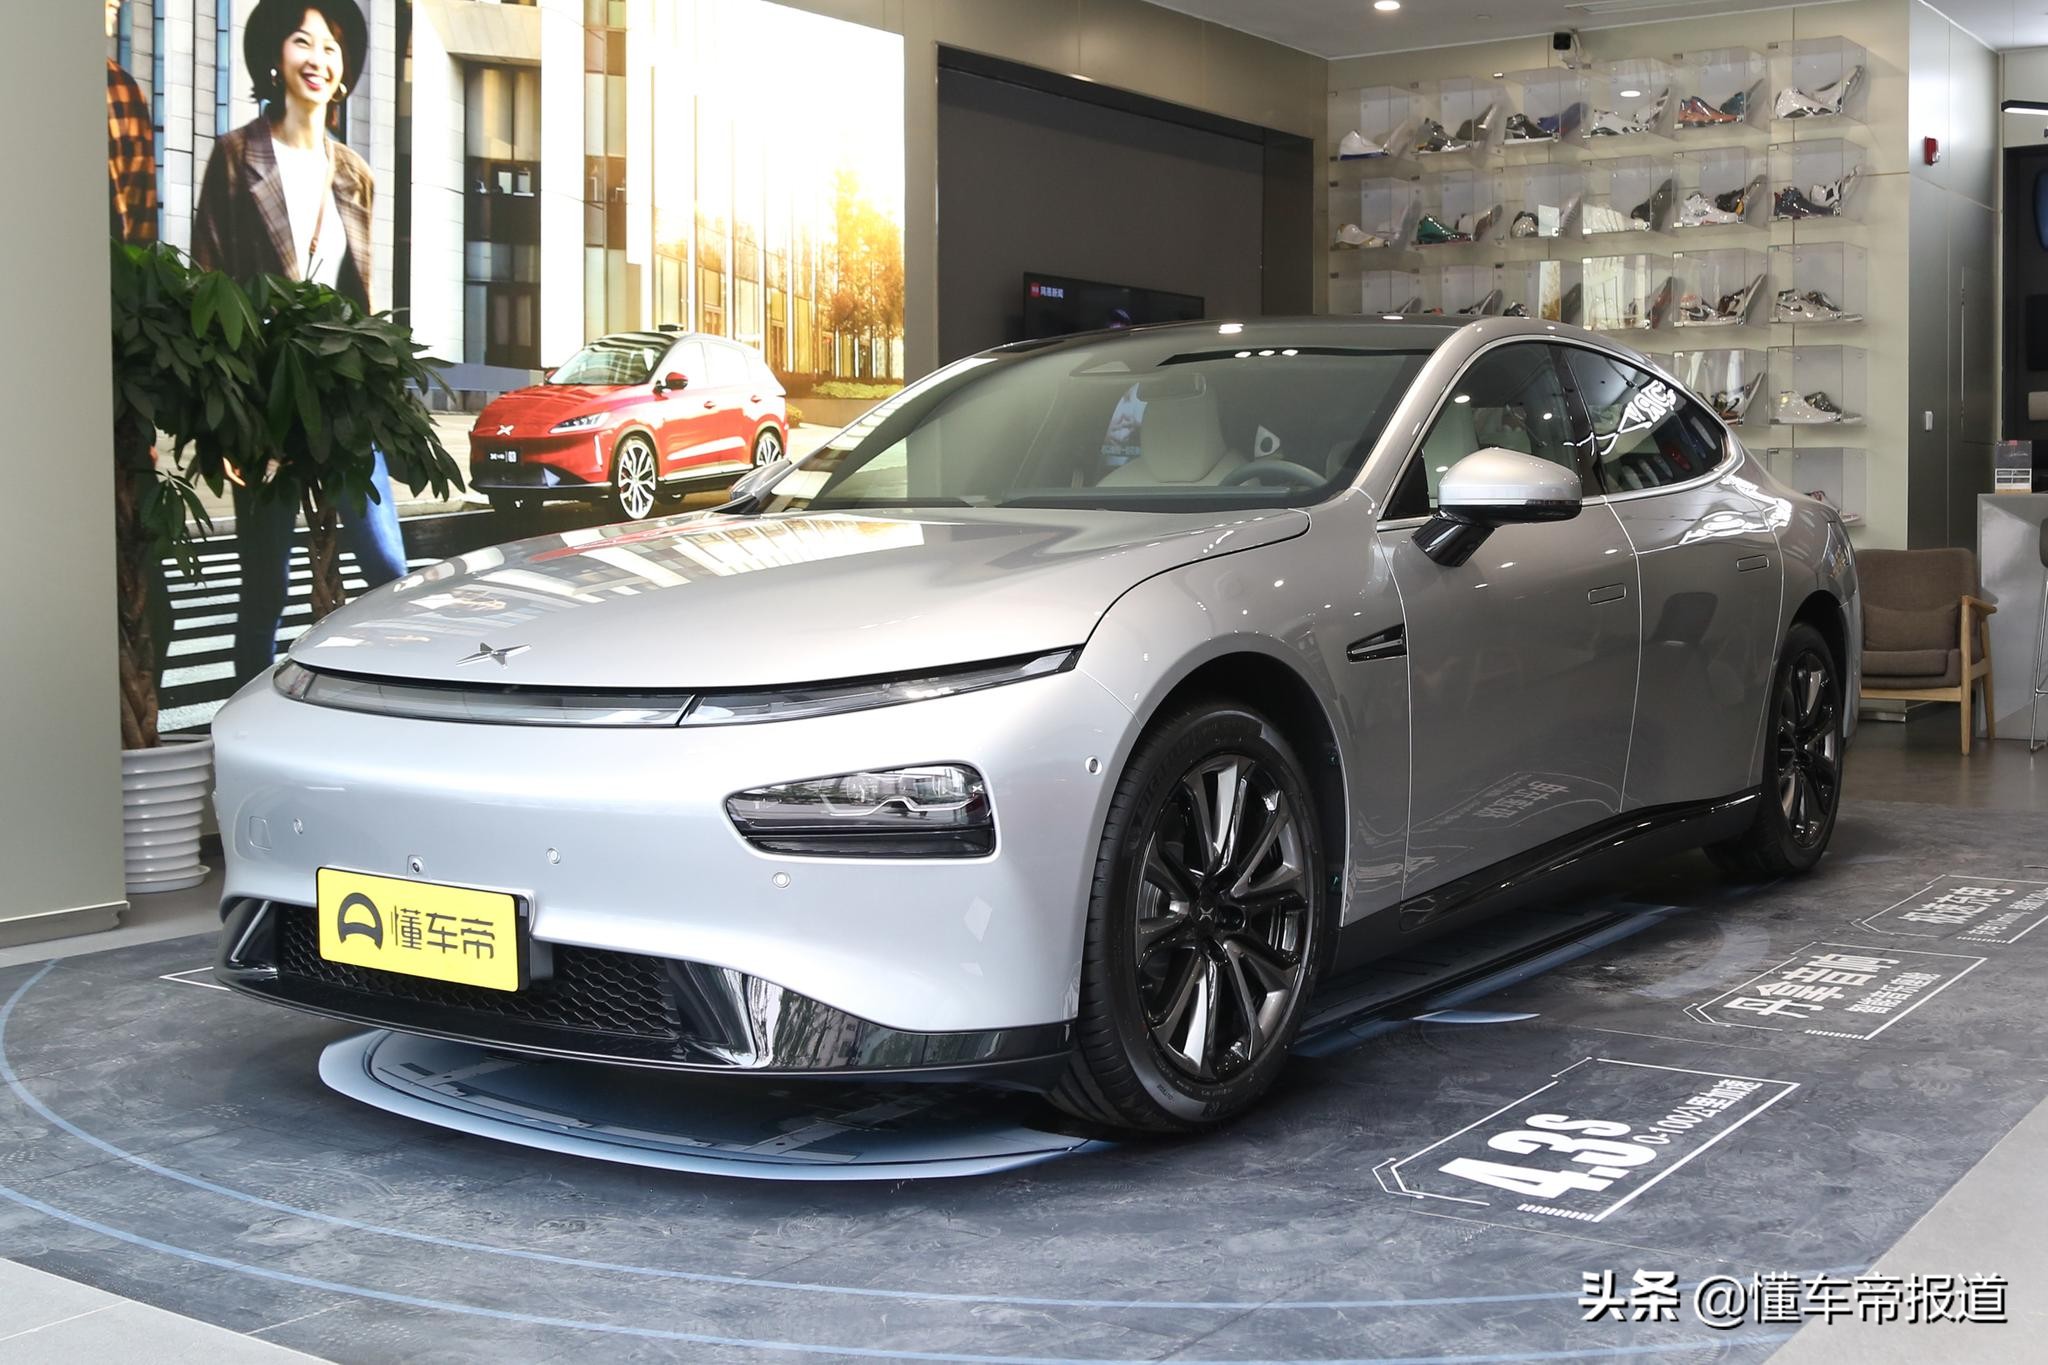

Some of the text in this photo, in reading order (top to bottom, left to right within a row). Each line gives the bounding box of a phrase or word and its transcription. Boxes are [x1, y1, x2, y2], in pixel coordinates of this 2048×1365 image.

[390, 905, 496, 959] 懂车帝
[1898, 886, 2015, 924] 极速充电
[1723, 953, 1901, 1019] 丹拿音响
[1631, 1078, 1764, 1145] 0-100公里加速
